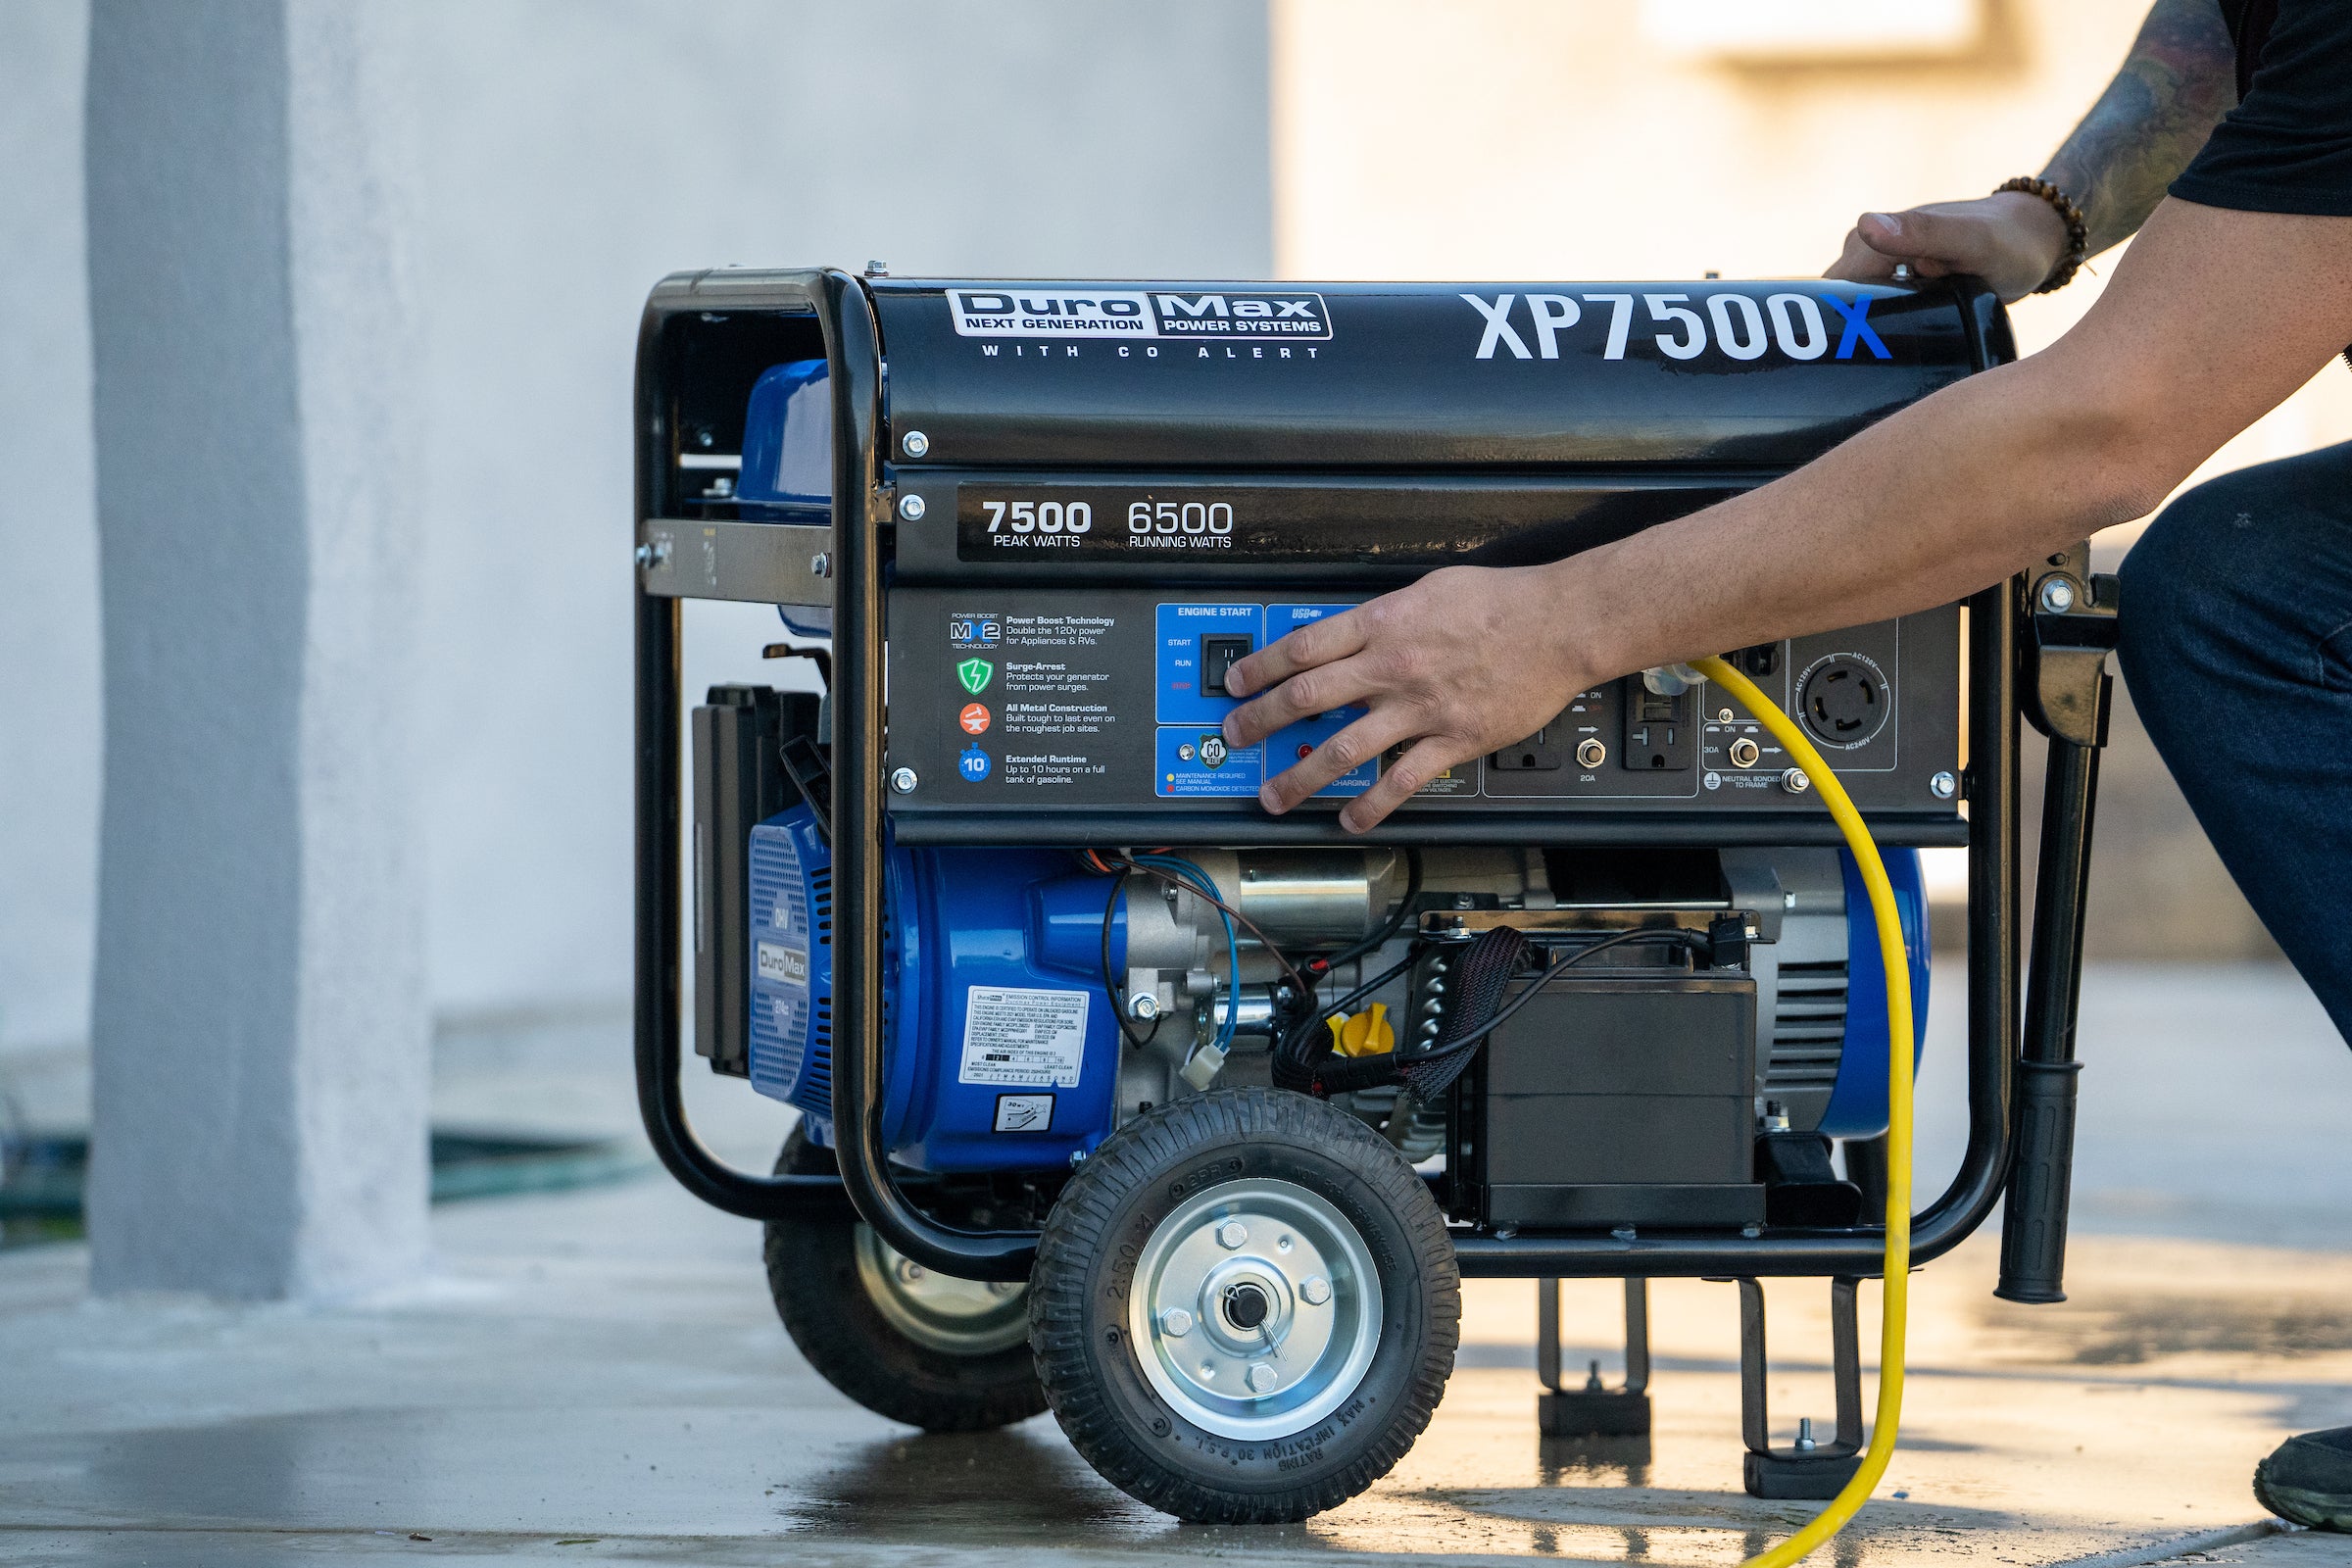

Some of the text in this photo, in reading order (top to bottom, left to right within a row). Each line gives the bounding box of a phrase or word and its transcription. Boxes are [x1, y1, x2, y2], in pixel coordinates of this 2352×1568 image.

[965, 318, 1321, 332] NEXT GENERATION POWER SYSTEMS
[1459, 293, 1893, 361] XP7500X
[982, 345, 1317, 359] WITH CO ALERT
[982, 501, 1092, 533] 7500
[1128, 501, 1233, 534] 6500
[993, 535, 1080, 547] PEAK WATTS
[1129, 536, 1232, 548] RUNNING WATTS
[1178, 608, 1252, 616] ENGINE START
[1292, 608, 1311, 619] USB
[1005, 615, 1114, 627] Power Boost Technology
[1005, 626, 1036, 635] Double
[1037, 626, 1053, 635] the
[1020, 637, 1067, 646] Appliances
[1851, 652, 1878, 668] AC120V
[1005, 662, 1066, 671] Surge-Arrest
[1005, 672, 1044, 681] Protects
[1066, 673, 1110, 682] generator
[1795, 666, 1812, 693] AC120V
[1028, 684, 1055, 693] power
[1056, 684, 1089, 693] surges.
[1005, 704, 1108, 712] All Metal Construction
[1005, 713, 1026, 722] Built
[1026, 713, 1053, 724] tough
[1064, 713, 1082, 722] last
[1005, 724, 1101, 734] the roughest job sites.
[1844, 737, 1871, 751] AC240V
[1206, 743, 1220, 758] CO
[1005, 755, 1087, 763] Extended Runtime
[963, 758, 985, 772] 10
[1005, 765, 1018, 775] Up
[1005, 775, 1074, 785] tank of gasoline.
